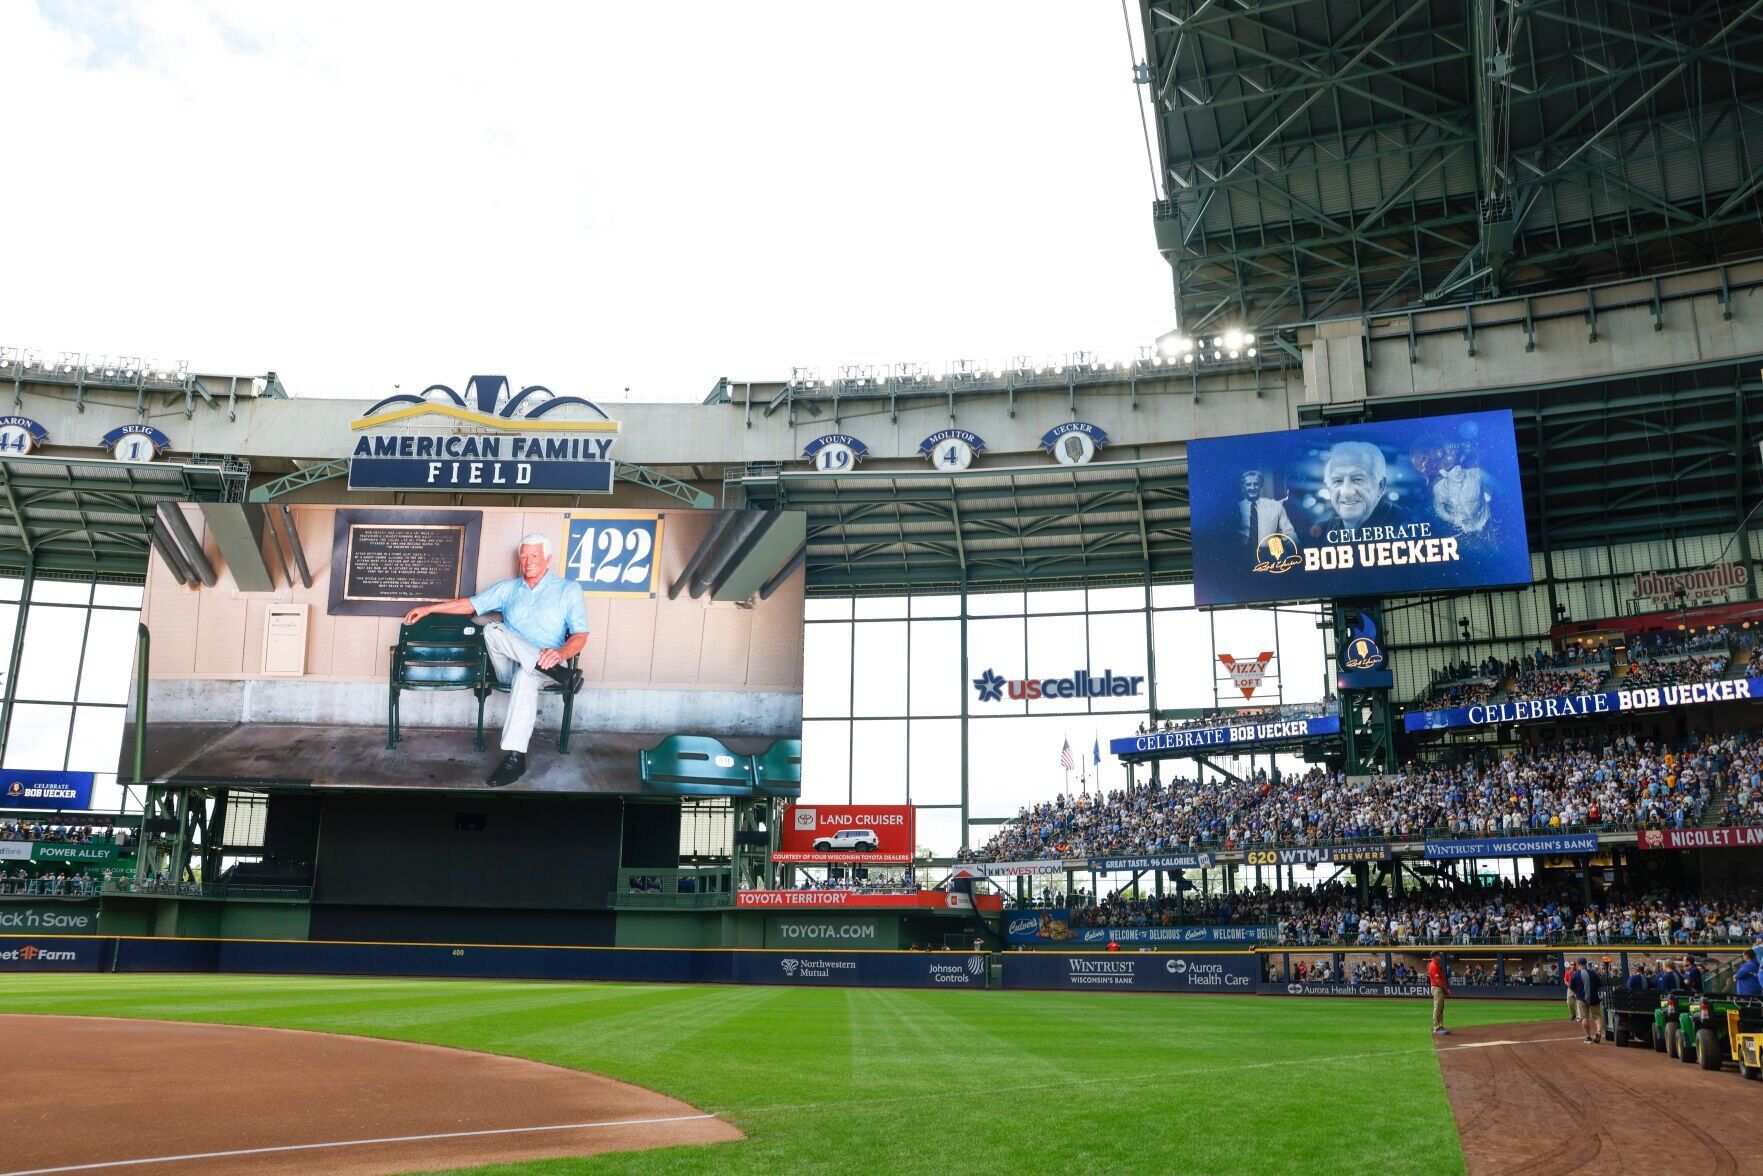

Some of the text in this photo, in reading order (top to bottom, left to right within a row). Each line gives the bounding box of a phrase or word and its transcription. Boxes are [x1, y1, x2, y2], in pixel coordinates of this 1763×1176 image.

[122, 426, 153, 435] SELIG
[1053, 423, 1093, 436] UECKER
[819, 435, 854, 445] YOUNT
[929, 430, 975, 444] MOLITOR
[129, 442, 140, 460] 1
[353, 436, 613, 459] AMERICAN FAMILY
[822, 450, 849, 469] 19
[943, 445, 958, 465] 4
[427, 461, 532, 484] FIELD
[1326, 523, 1431, 543] CELEBRATE
[568, 527, 651, 583] 422
[1304, 537, 1459, 571] BOB UECKER
[1633, 562, 1746, 597] Johnsonville
[1652, 588, 1728, 604] PARY DECK
[1227, 663, 1265, 673] VIZZY
[1008, 669, 1144, 700] uscellular
[1235, 678, 1261, 687] LOFT
[1468, 678, 1750, 725] CELEBRATE BOB UECKER
[1136, 720, 1309, 750] CELEBRATE BOB UECKER
[24, 788, 42, 797] BOB
[43, 789, 76, 798] UECKER
[820, 815, 904, 825] LAND CRUISER
[1671, 829, 1730, 847] NICOLET
[40, 847, 110, 858] POWER ALLEY
[1427, 839, 1593, 855] WINTRUST WISCONSIN'S BANK
[1247, 848, 1329, 865] 620 WTMJ
[1333, 851, 1385, 861] BREWERS
[1105, 859, 1127, 869] GREAT
[1128, 859, 1150, 868] TASTE.
[1151, 858, 1160, 867] 96
[1161, 857, 1196, 866] CALORIES.
[740, 893, 847, 904] TOYOTA TERRITORY
[42, 912, 88, 927] Save
[781, 925, 875, 938] TOYOTA.COM
[1009, 918, 1039, 935] Culver's
[1109, 929, 1139, 941] WELCOME
[1149, 929, 1181, 940] DELICIOUS
[1213, 928, 1246, 940] WELCOME
[38, 949, 76, 960] Farm
[800, 960, 856, 969] Northwestern
[929, 964, 962, 974] Johnson
[1069, 959, 1135, 972] WINTRUST
[1188, 962, 1223, 973] Aurora
[800, 968, 829, 977] Mutual
[935, 974, 969, 983] Controls
[1071, 976, 1113, 984] WISCONSIN'S
[1188, 973, 1249, 986] Health Care
[1303, 985, 1378, 995] Aurora Health Care
[1384, 986, 1431, 996] BULLPEN
